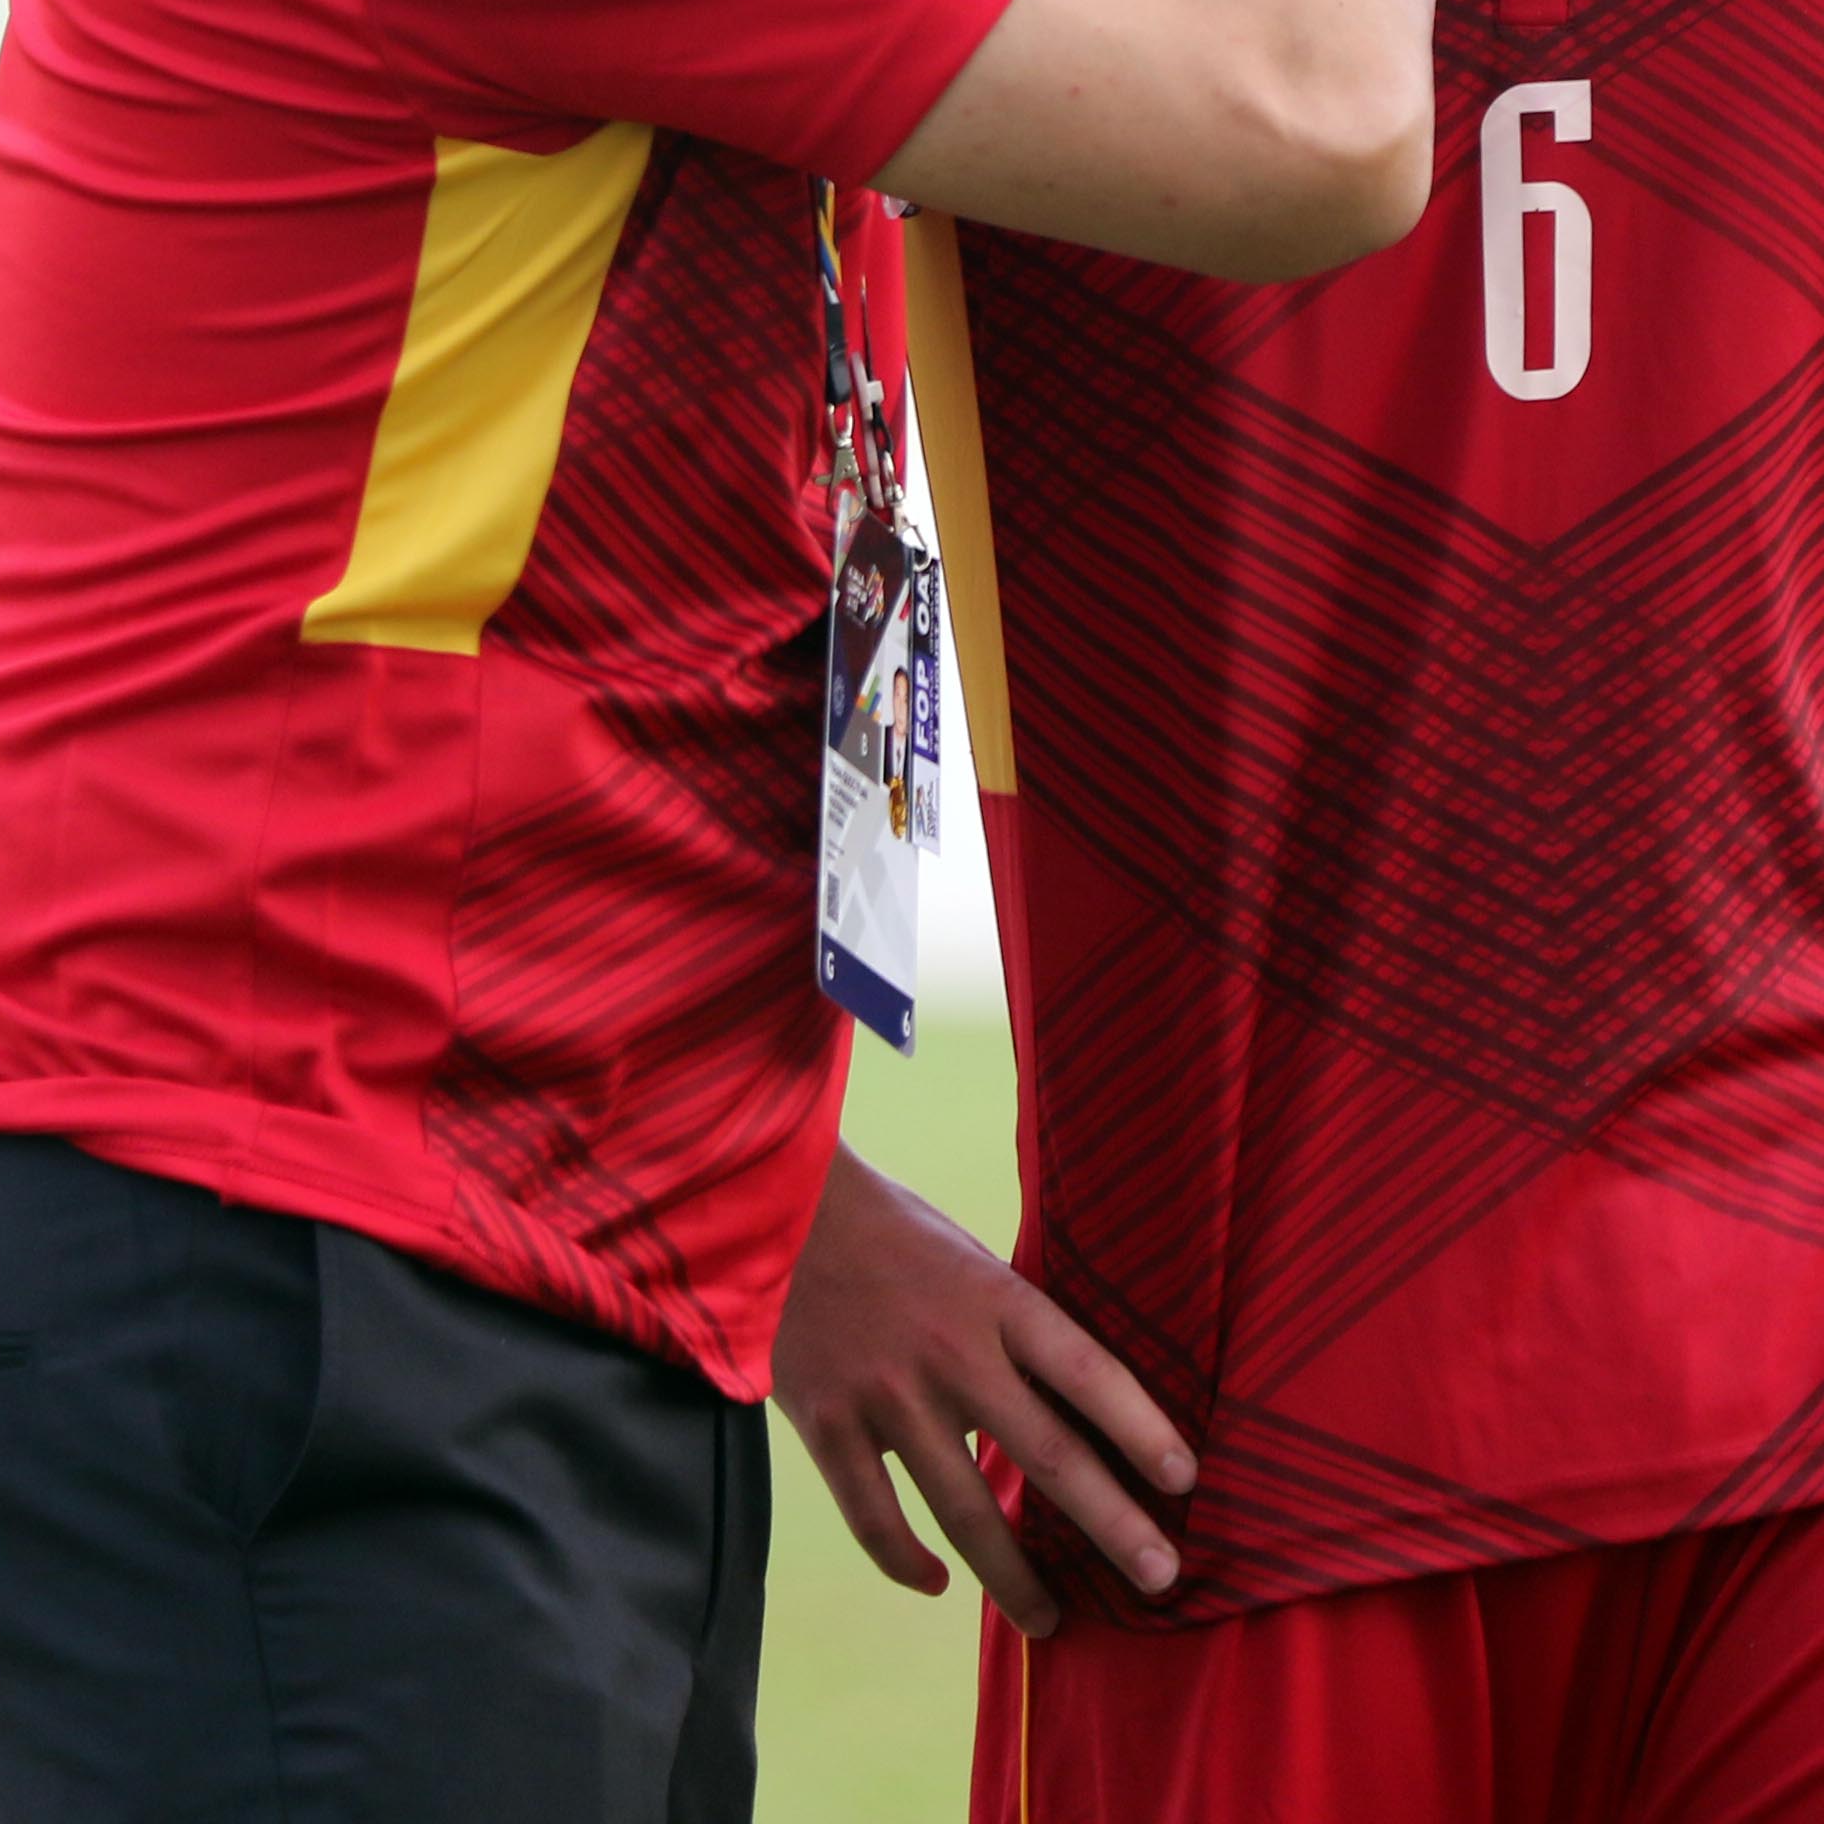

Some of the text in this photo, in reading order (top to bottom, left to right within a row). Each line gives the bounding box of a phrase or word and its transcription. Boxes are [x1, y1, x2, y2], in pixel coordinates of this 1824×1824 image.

[1481, 80, 1592, 401] 6
[915, 574, 929, 750] FOP OA
